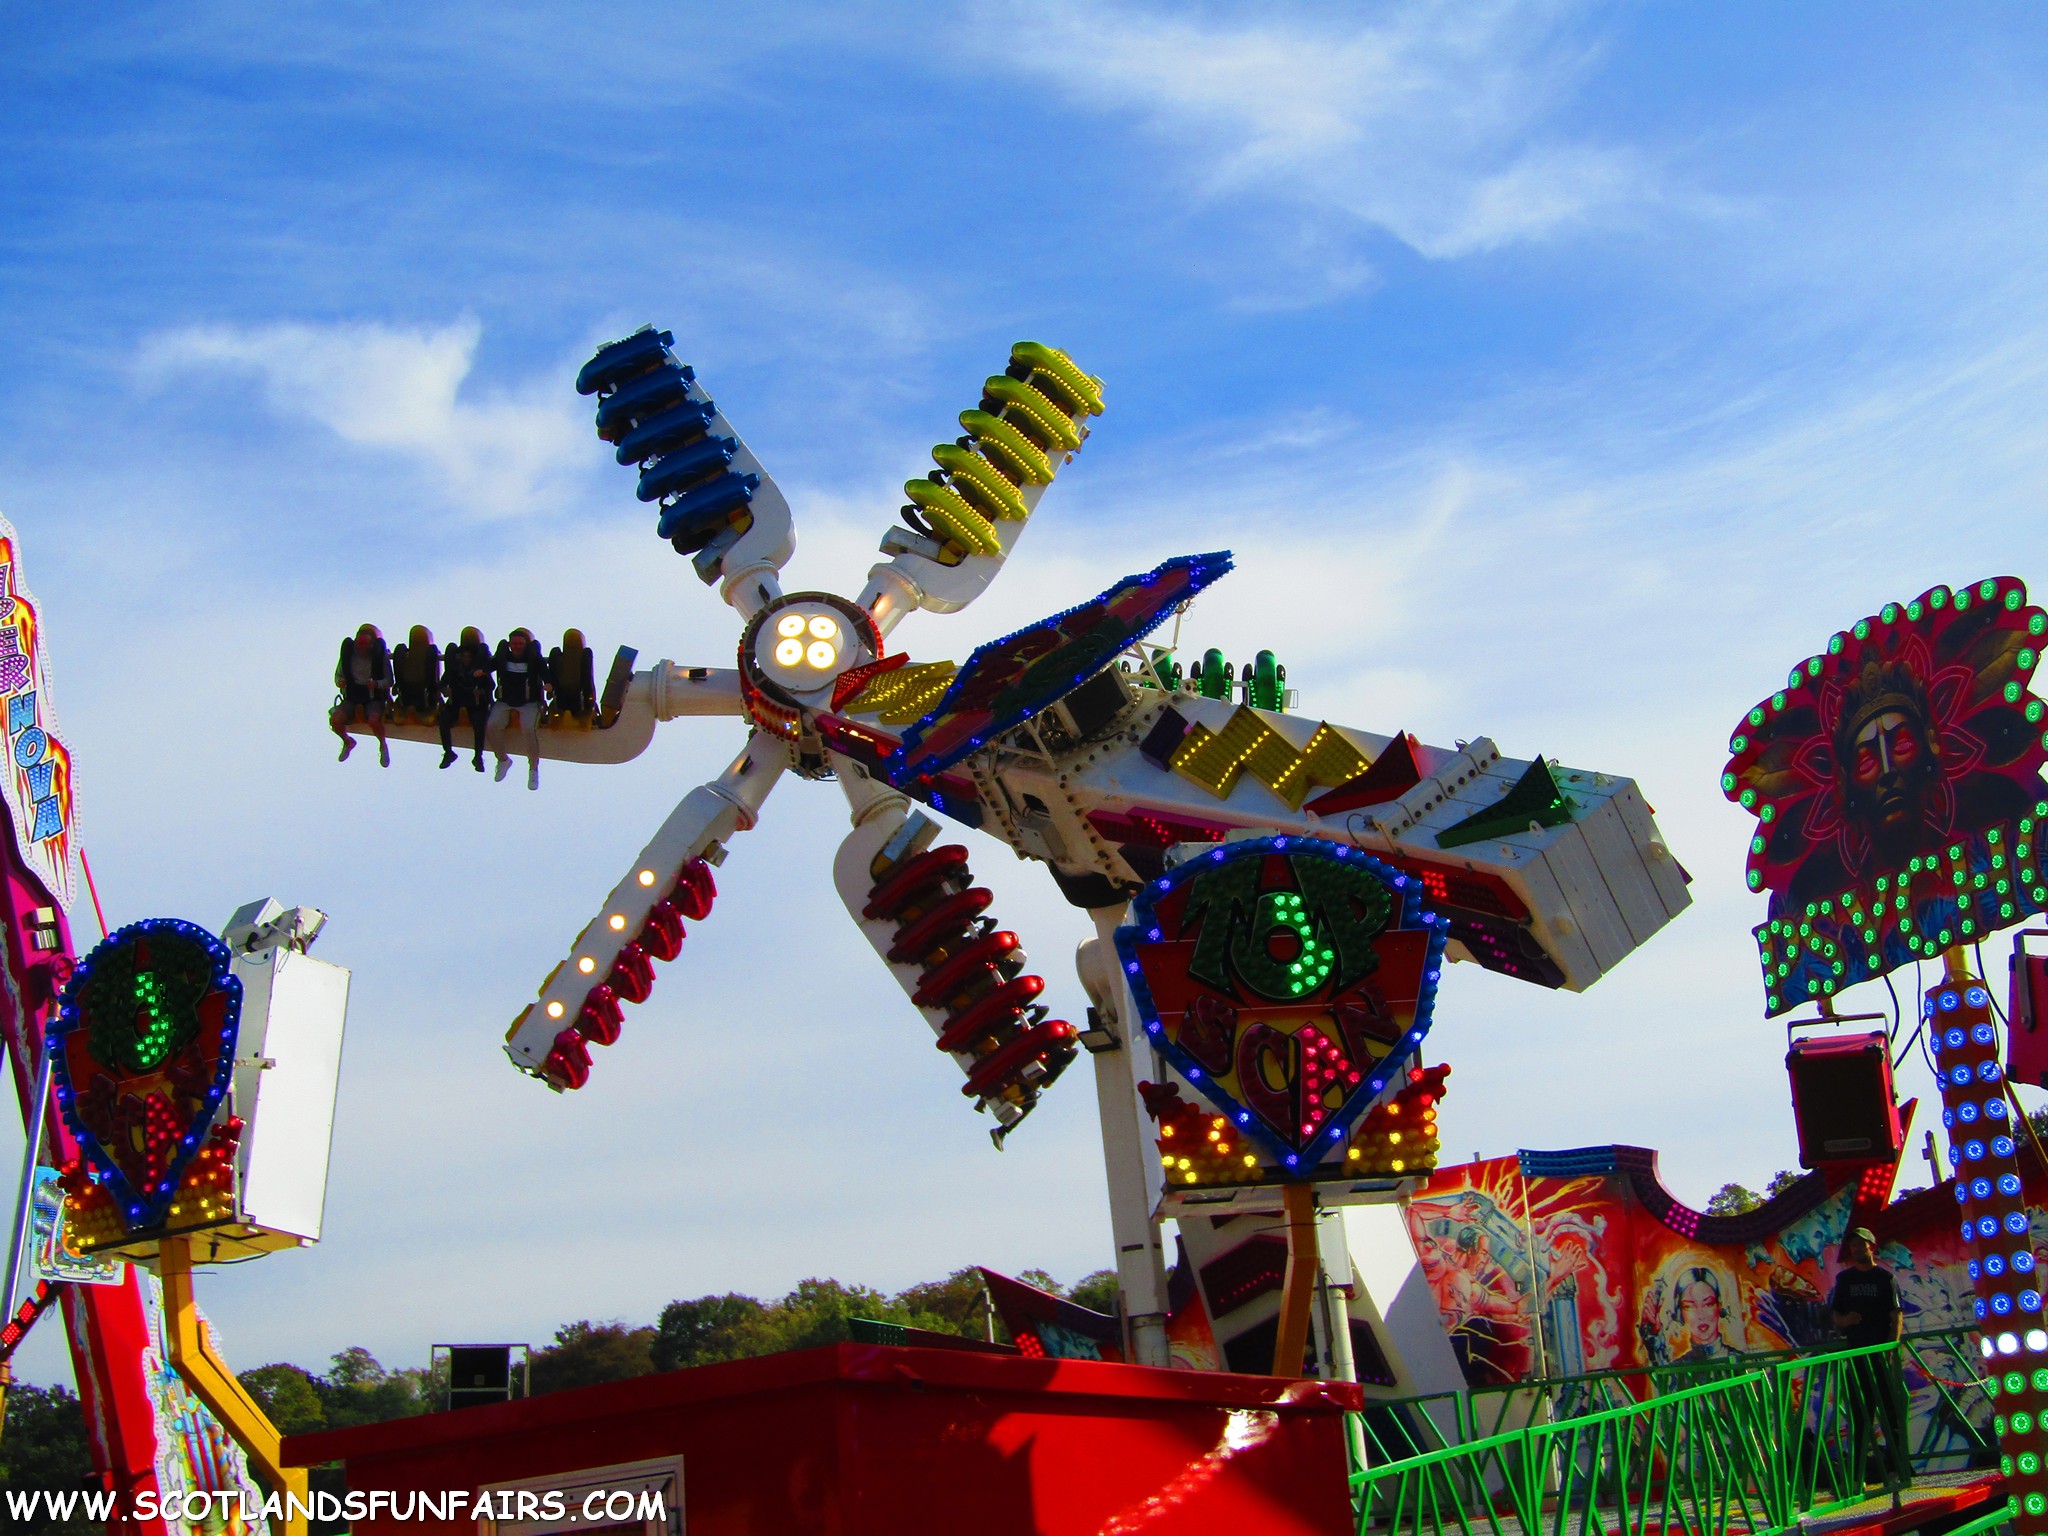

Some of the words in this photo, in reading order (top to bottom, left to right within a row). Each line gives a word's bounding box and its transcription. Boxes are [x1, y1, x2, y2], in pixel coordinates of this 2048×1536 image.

[9, 691, 64, 842] NOVA
[1178, 854, 1392, 999] TOP
[1177, 987, 1402, 1146] SCAN
